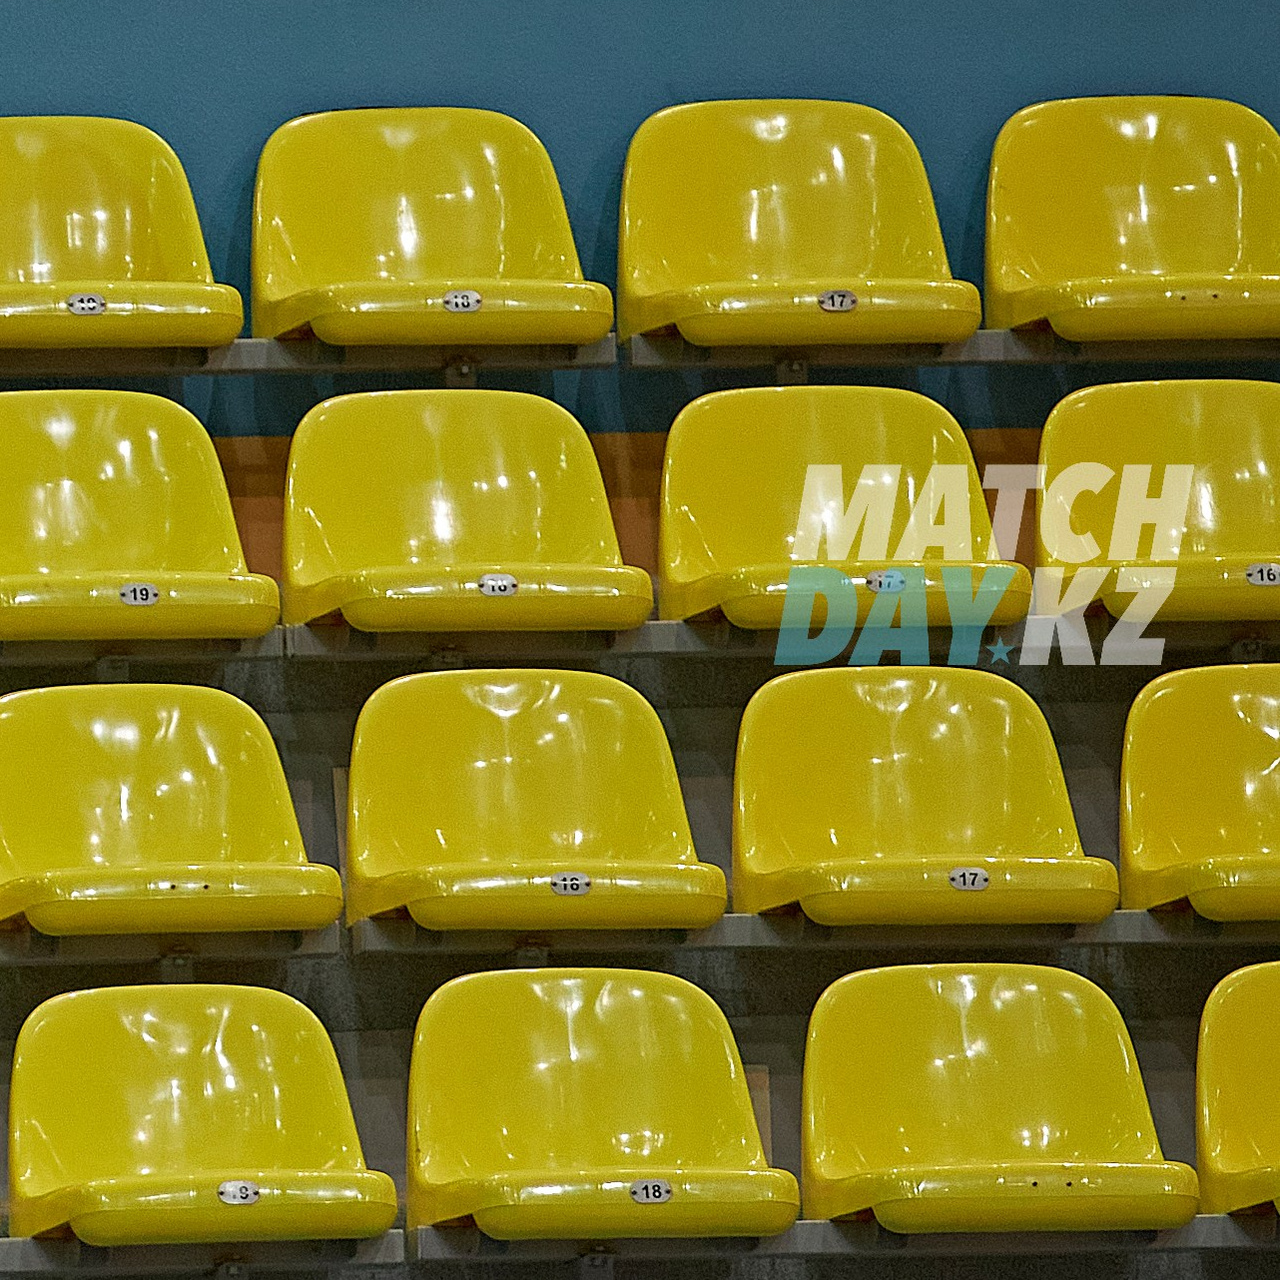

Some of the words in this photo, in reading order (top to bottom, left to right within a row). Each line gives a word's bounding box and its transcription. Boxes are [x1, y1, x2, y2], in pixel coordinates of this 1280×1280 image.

[829, 295, 845, 306] 17
[1257, 568, 1276, 581] 16
[131, 588, 149, 600] 19
[959, 873, 978, 886] 17
[232, 1186, 248, 1199] 9
[642, 1185, 661, 1198] 18
